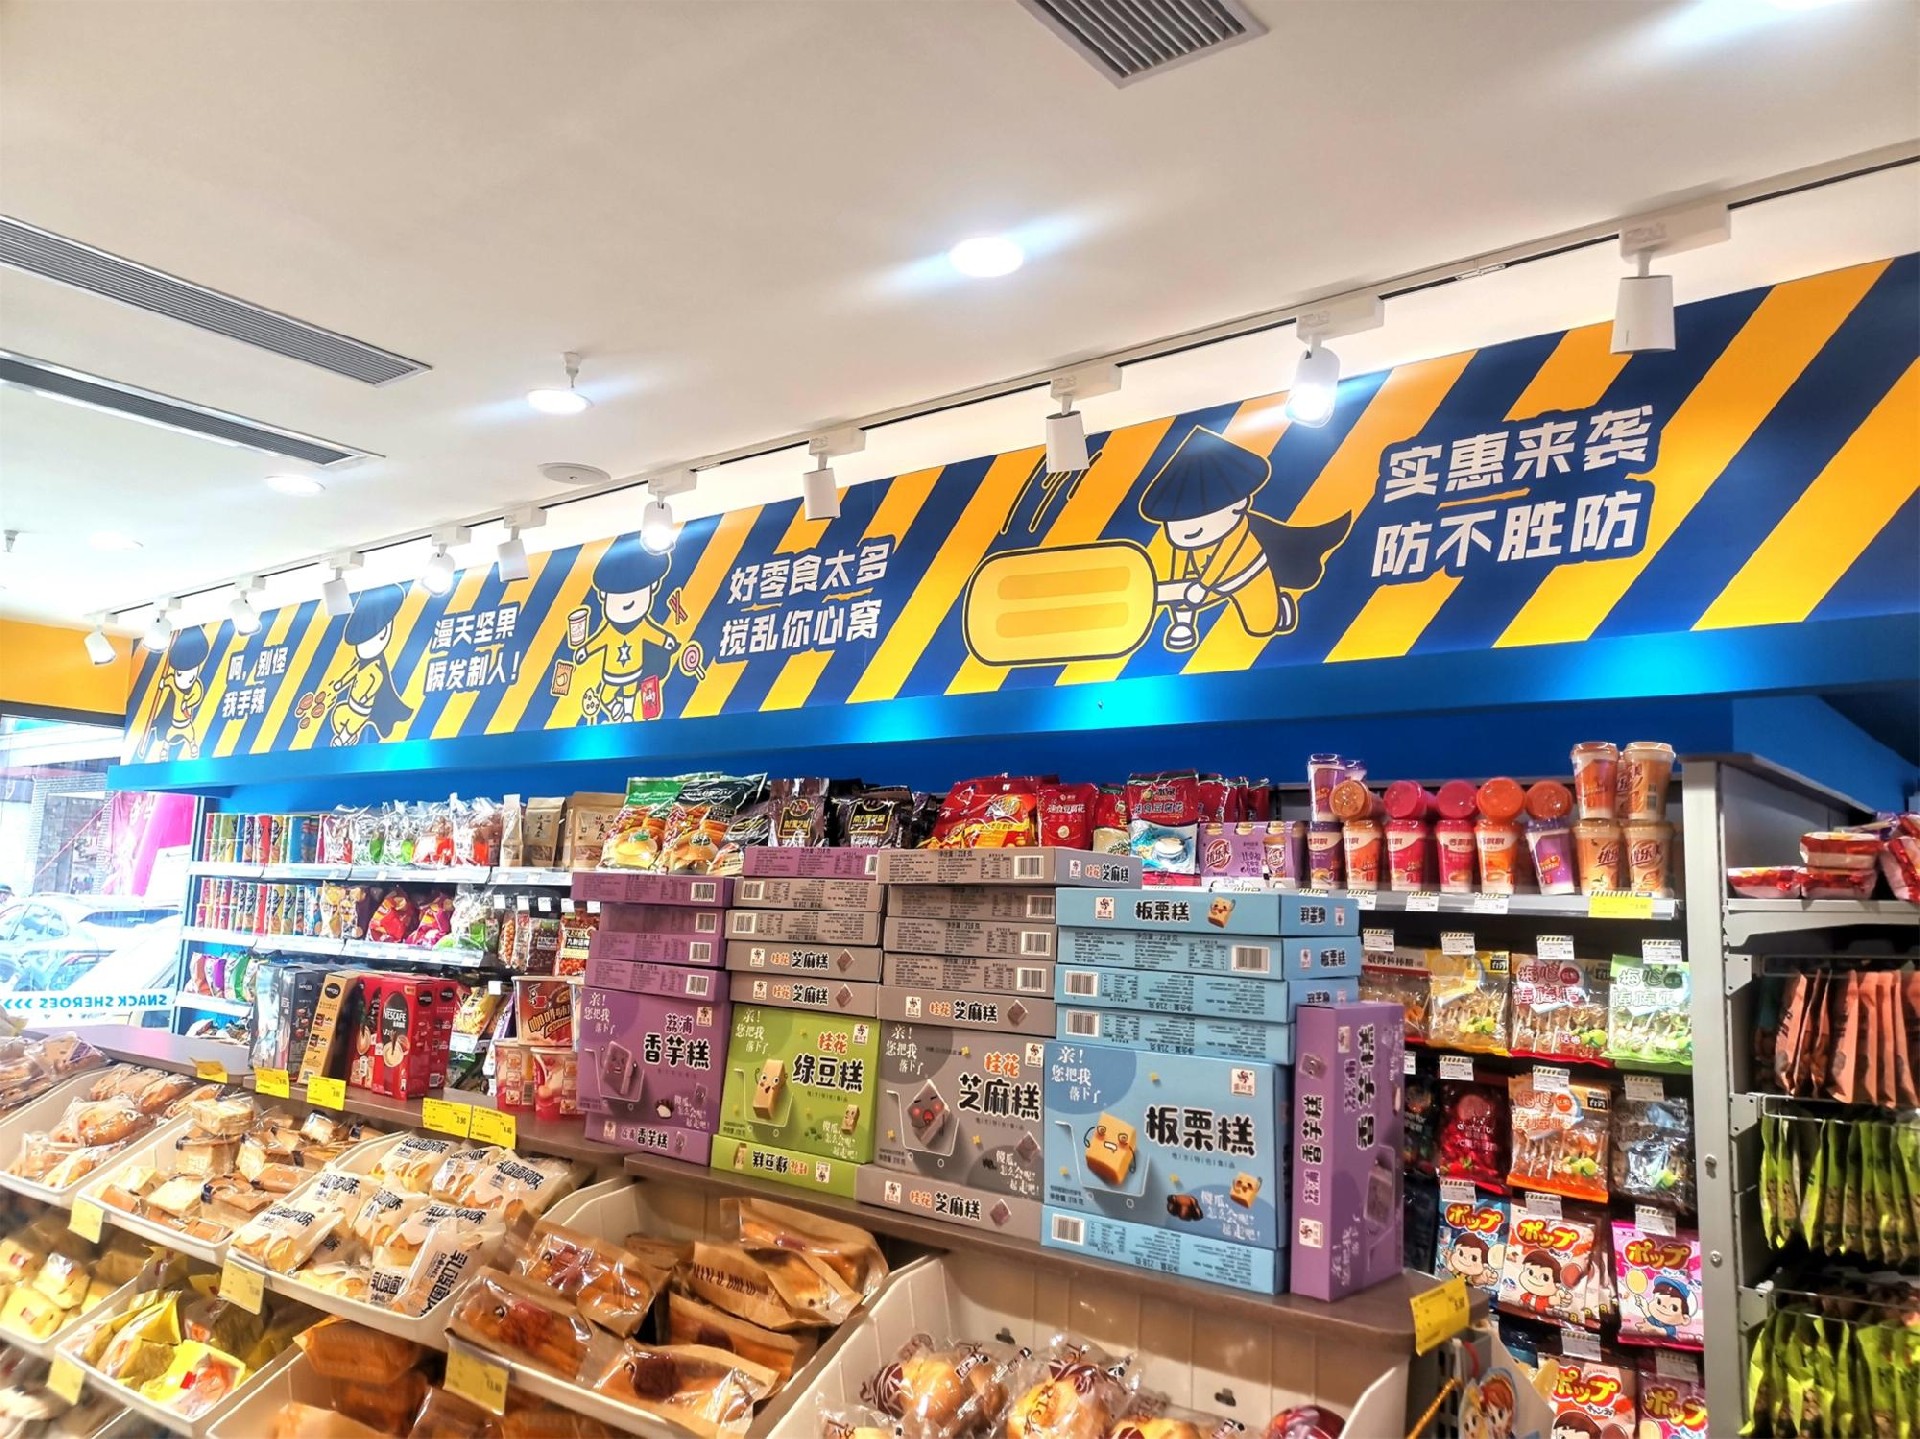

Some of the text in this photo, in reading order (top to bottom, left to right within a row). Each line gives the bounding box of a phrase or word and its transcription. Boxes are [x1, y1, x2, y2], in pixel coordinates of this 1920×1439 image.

[1384, 405, 1653, 503] 实惠来袭
[1371, 490, 1642, 577] 防不胜防
[727, 543, 889, 604] 好零食太多
[431, 606, 518, 649] 漫天坚果
[719, 599, 882, 657] 搅乱你心窝
[1101, 863, 1131, 883] 芝麻糕
[1135, 901, 1190, 922] 板栗糕
[791, 949, 830, 970] 芝麻糕
[791, 983, 830, 1006] 芝麻糕
[665, 1013, 693, 1035] 荔浦
[929, 999, 999, 1023] 桂花 芝麻糕
[645, 1032, 711, 1070] 香芋糕
[818, 1031, 848, 1055] 桂花
[885, 1040, 918, 1060] 您把我
[1057, 1046, 1083, 1064] 亲！
[792, 1053, 864, 1094] 绿豆糕
[984, 1051, 1020, 1078] 桂花
[1052, 1064, 1092, 1087] 您把我
[957, 1072, 1041, 1122] 芝麻糕
[1069, 1086, 1101, 1104] 落下了
[637, 1127, 668, 1148] 香芋糕
[1144, 1104, 1257, 1158] 板栗糕
[1301, 1095, 1324, 1164] 香芋糕
[752, 1150, 789, 1175] 绿豆糕
[909, 1190, 981, 1221] 桂花 芝麻糕
[1447, 1204, 1502, 1231] ポップ
[1518, 1220, 1579, 1249] ポップ
[1628, 1239, 1690, 1268] ポップ
[1557, 1368, 1619, 1403] ポップ
[1644, 1387, 1708, 1428] ポップ
